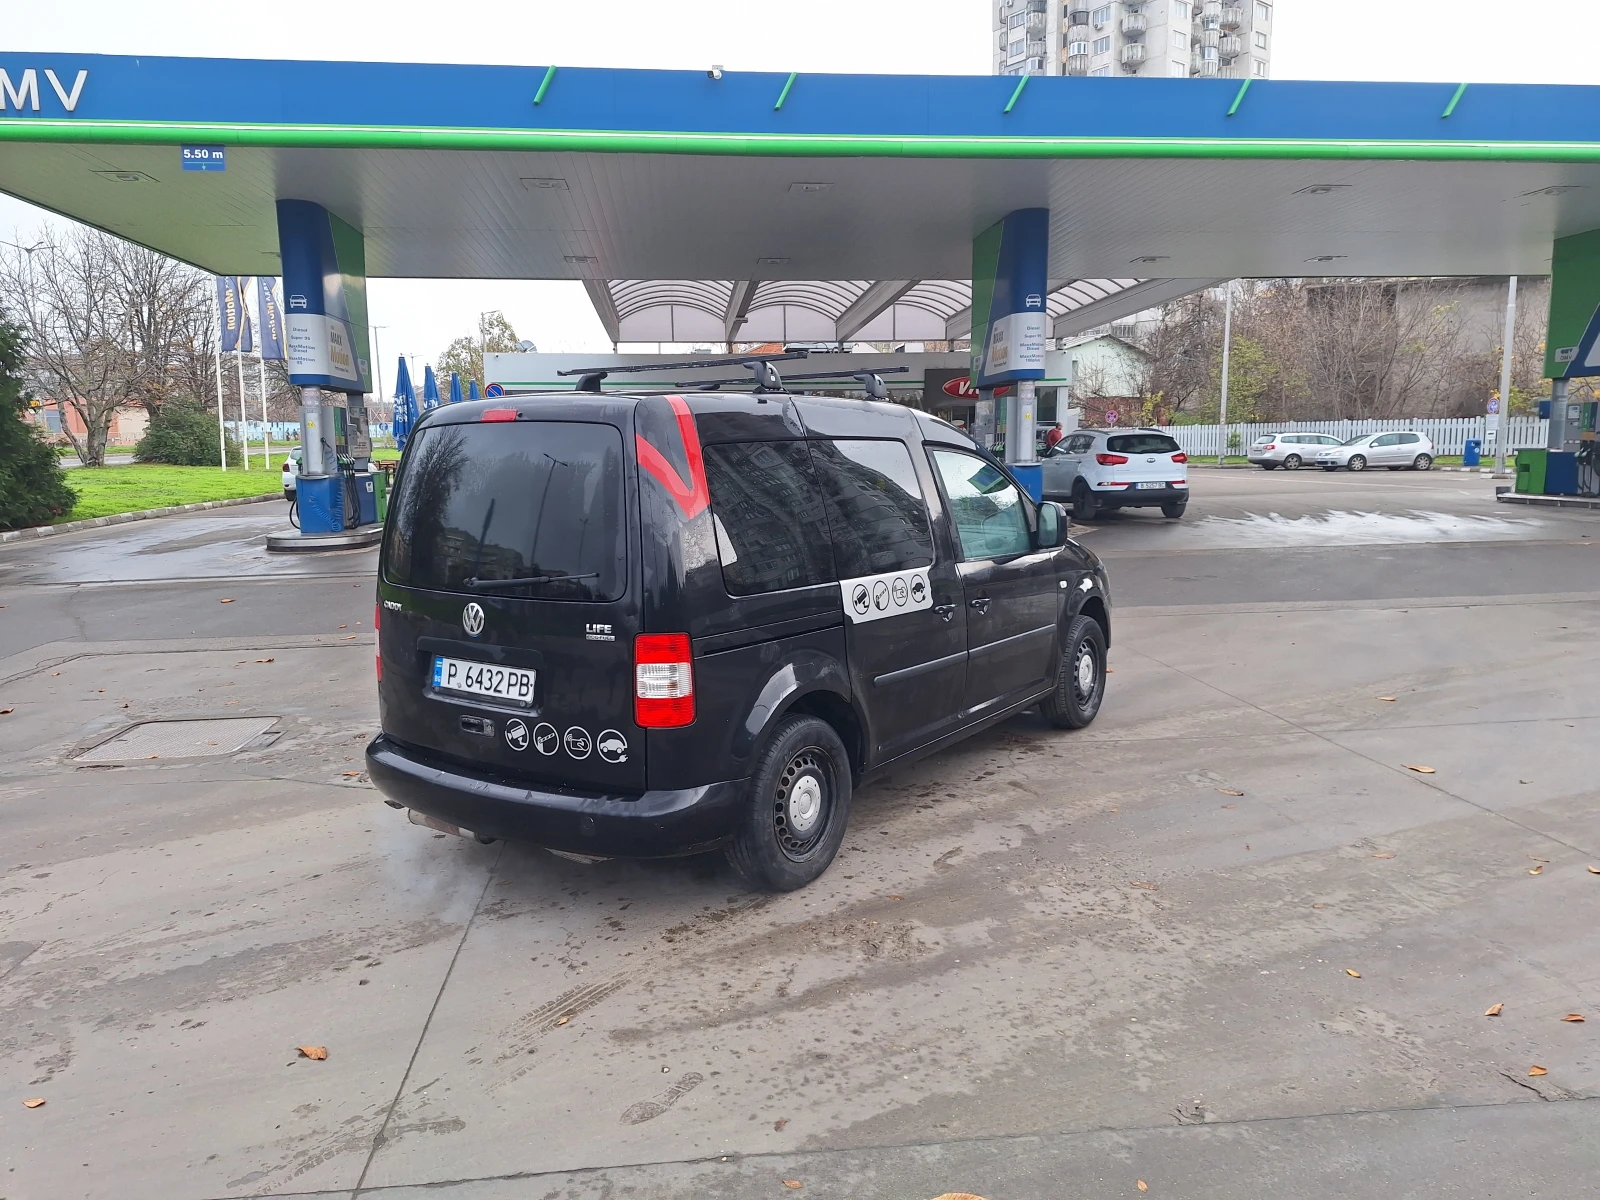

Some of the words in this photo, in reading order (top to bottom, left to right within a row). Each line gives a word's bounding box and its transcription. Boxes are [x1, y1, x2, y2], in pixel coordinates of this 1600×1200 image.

[183, 149, 209, 159] 5.50
[212, 151, 223, 159] m
[384, 600, 403, 612] CADDY
[585, 623, 612, 634] LIFE
[447, 662, 458, 685] P
[465, 665, 505, 694] 6432
[506, 671, 531, 697] PB
